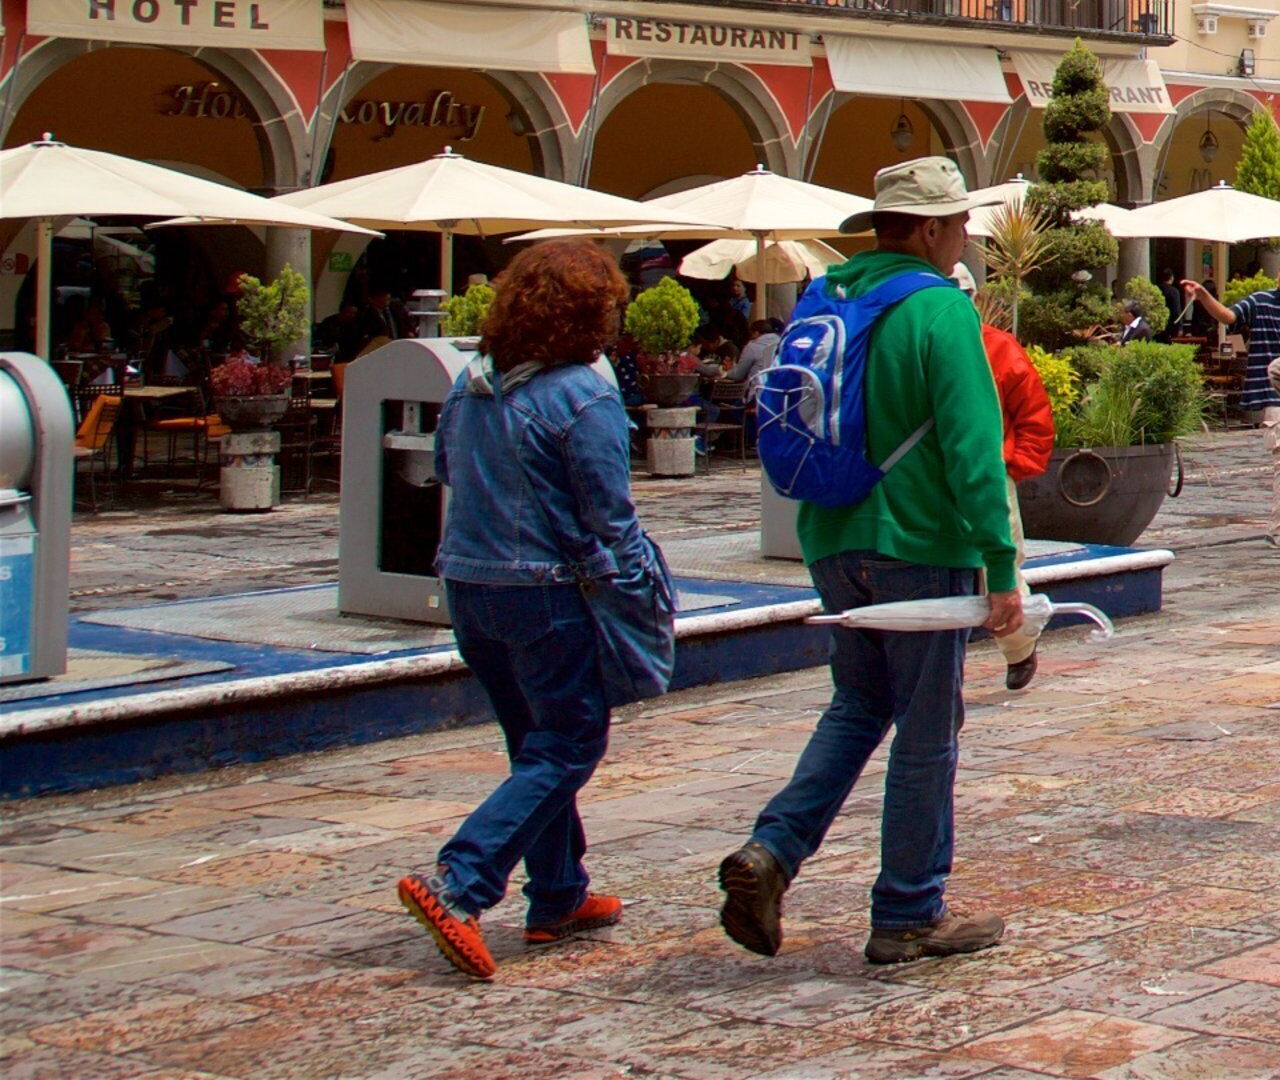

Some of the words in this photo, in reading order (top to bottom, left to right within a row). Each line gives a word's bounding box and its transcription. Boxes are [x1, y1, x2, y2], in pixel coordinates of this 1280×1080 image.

[614, 17, 802, 51] RESTAURANT
[168, 81, 248, 120] Hot
[1027, 80, 1164, 104] RERANT
